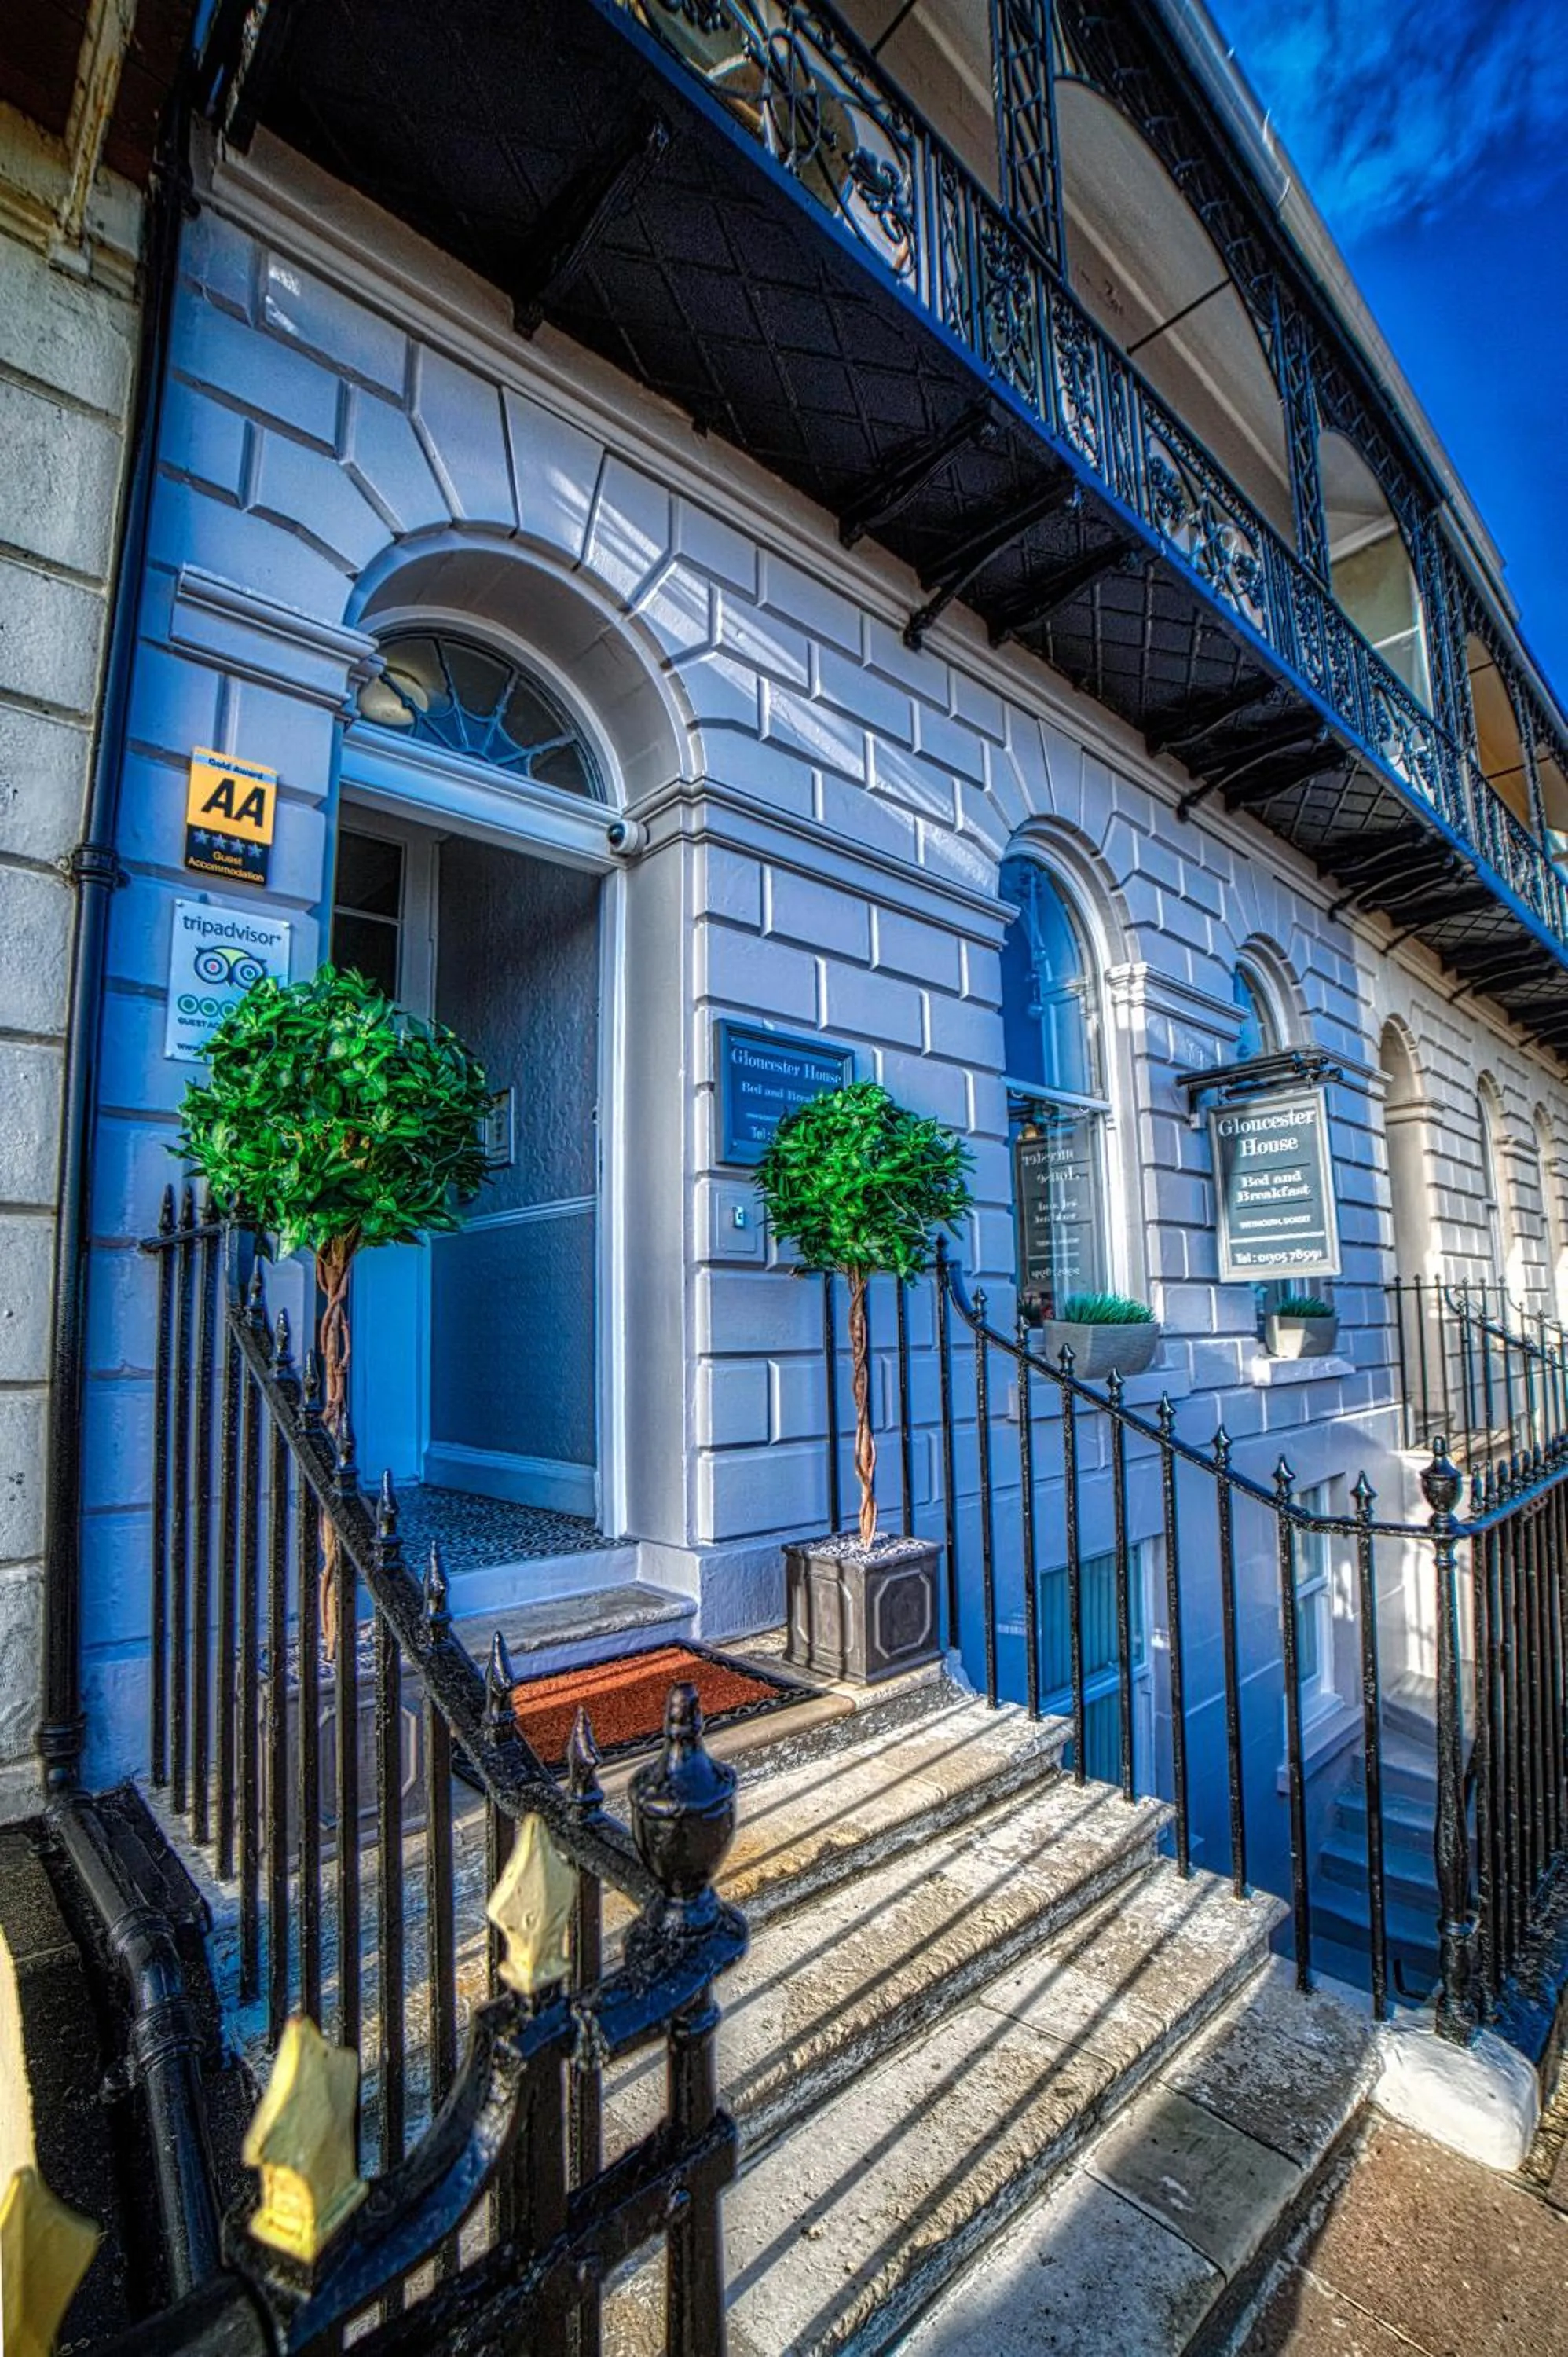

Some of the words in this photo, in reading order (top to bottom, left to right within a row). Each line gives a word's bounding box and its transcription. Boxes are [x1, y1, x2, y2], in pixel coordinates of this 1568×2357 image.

[208, 757, 232, 771] Gold
[233, 765, 265, 780] Award
[201, 777, 266, 827] AA
[189, 856, 265, 882] Accommodation
[212, 850, 243, 866] Guest
[182, 915, 277, 946] tripadvisor
[731, 1047, 800, 1076] Gloucester
[804, 1063, 842, 1085] House
[742, 1080, 762, 1094] Bed
[764, 1088, 783, 1098] and
[1218, 1108, 1316, 1136] Gloucester
[1240, 1136, 1299, 1157] House
[1240, 1172, 1269, 1189] Bed
[1273, 1170, 1302, 1184] and
[1236, 1182, 1311, 1203] Breakfast
